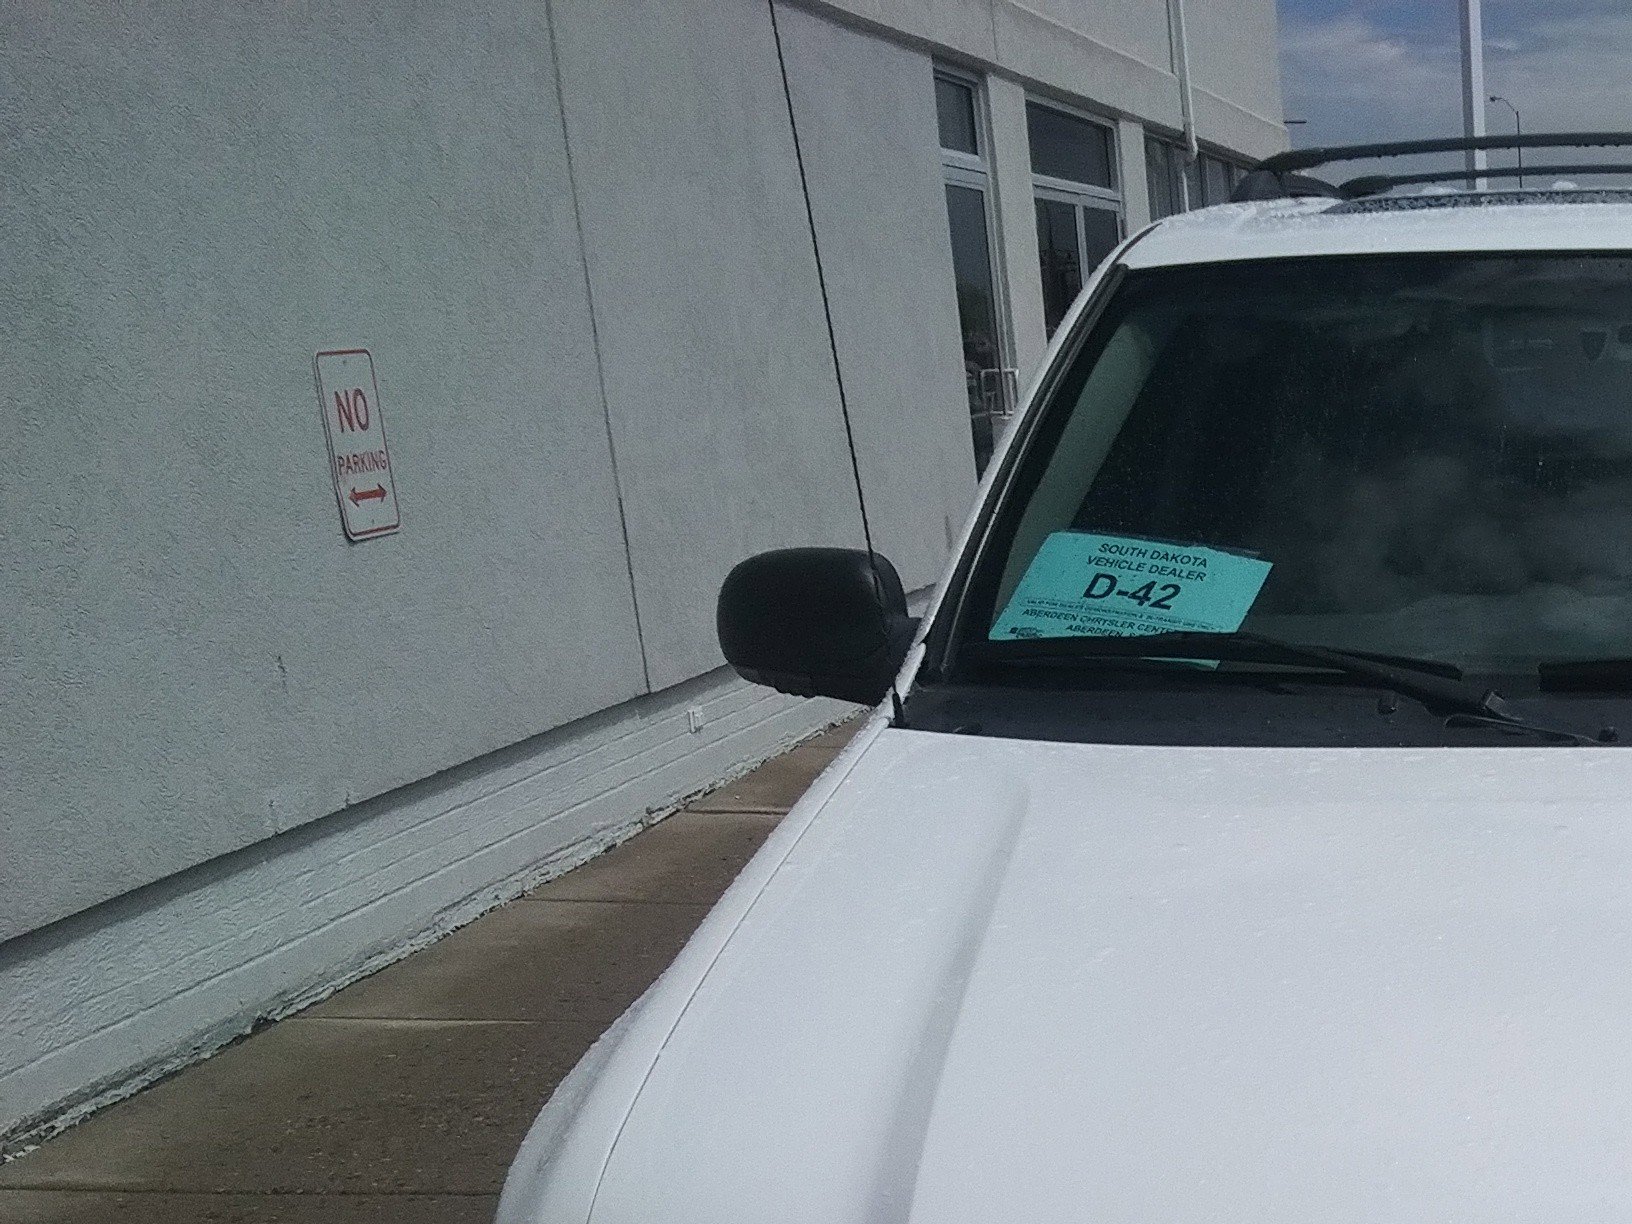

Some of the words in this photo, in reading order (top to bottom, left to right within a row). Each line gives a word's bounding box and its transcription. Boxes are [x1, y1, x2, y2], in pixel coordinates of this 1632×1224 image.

[334, 388, 370, 433] NO
[337, 450, 388, 476] PARKING
[1087, 555, 1147, 572] VEHICLE
[1148, 564, 1207, 582] DEALER
[1098, 543, 1148, 558] SOUTH
[1150, 550, 1208, 568] DAKOTA
[1083, 572, 1181, 611] D-42
[1022, 608, 1079, 622] ABERDEEN
[1080, 615, 1135, 629] CHRYSLER
[1137, 623, 1172, 634] CENT
